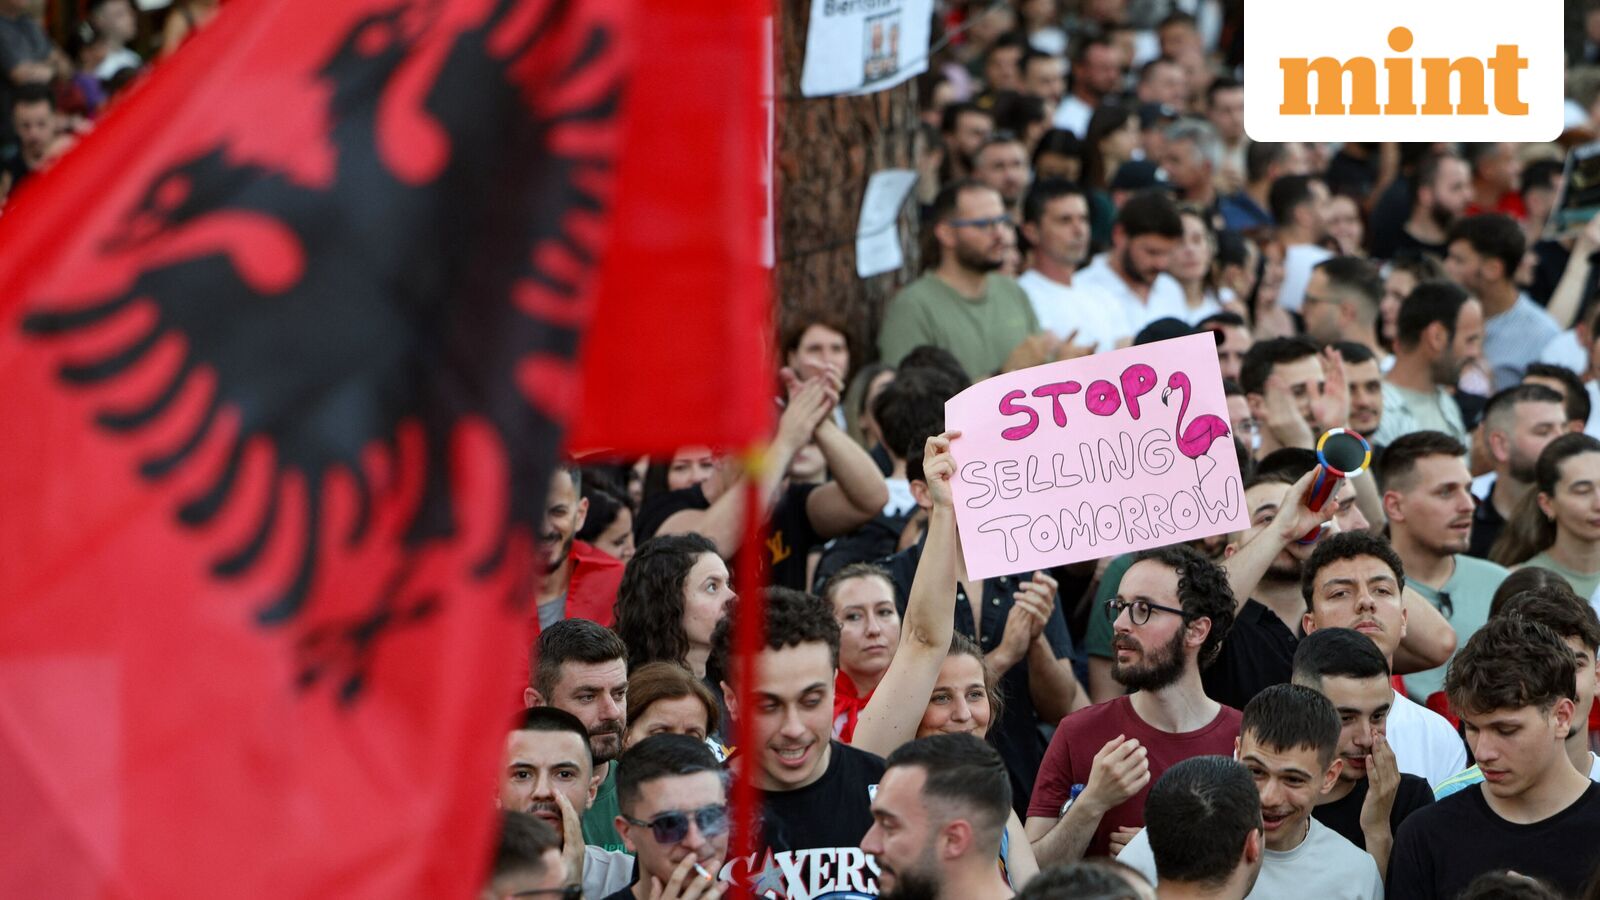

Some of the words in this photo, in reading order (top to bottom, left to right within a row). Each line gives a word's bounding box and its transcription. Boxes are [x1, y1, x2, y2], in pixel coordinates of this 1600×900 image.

[999, 363, 1158, 441] STOP
[961, 428, 1175, 508] SELLING
[978, 476, 1239, 562] TOMORROW
